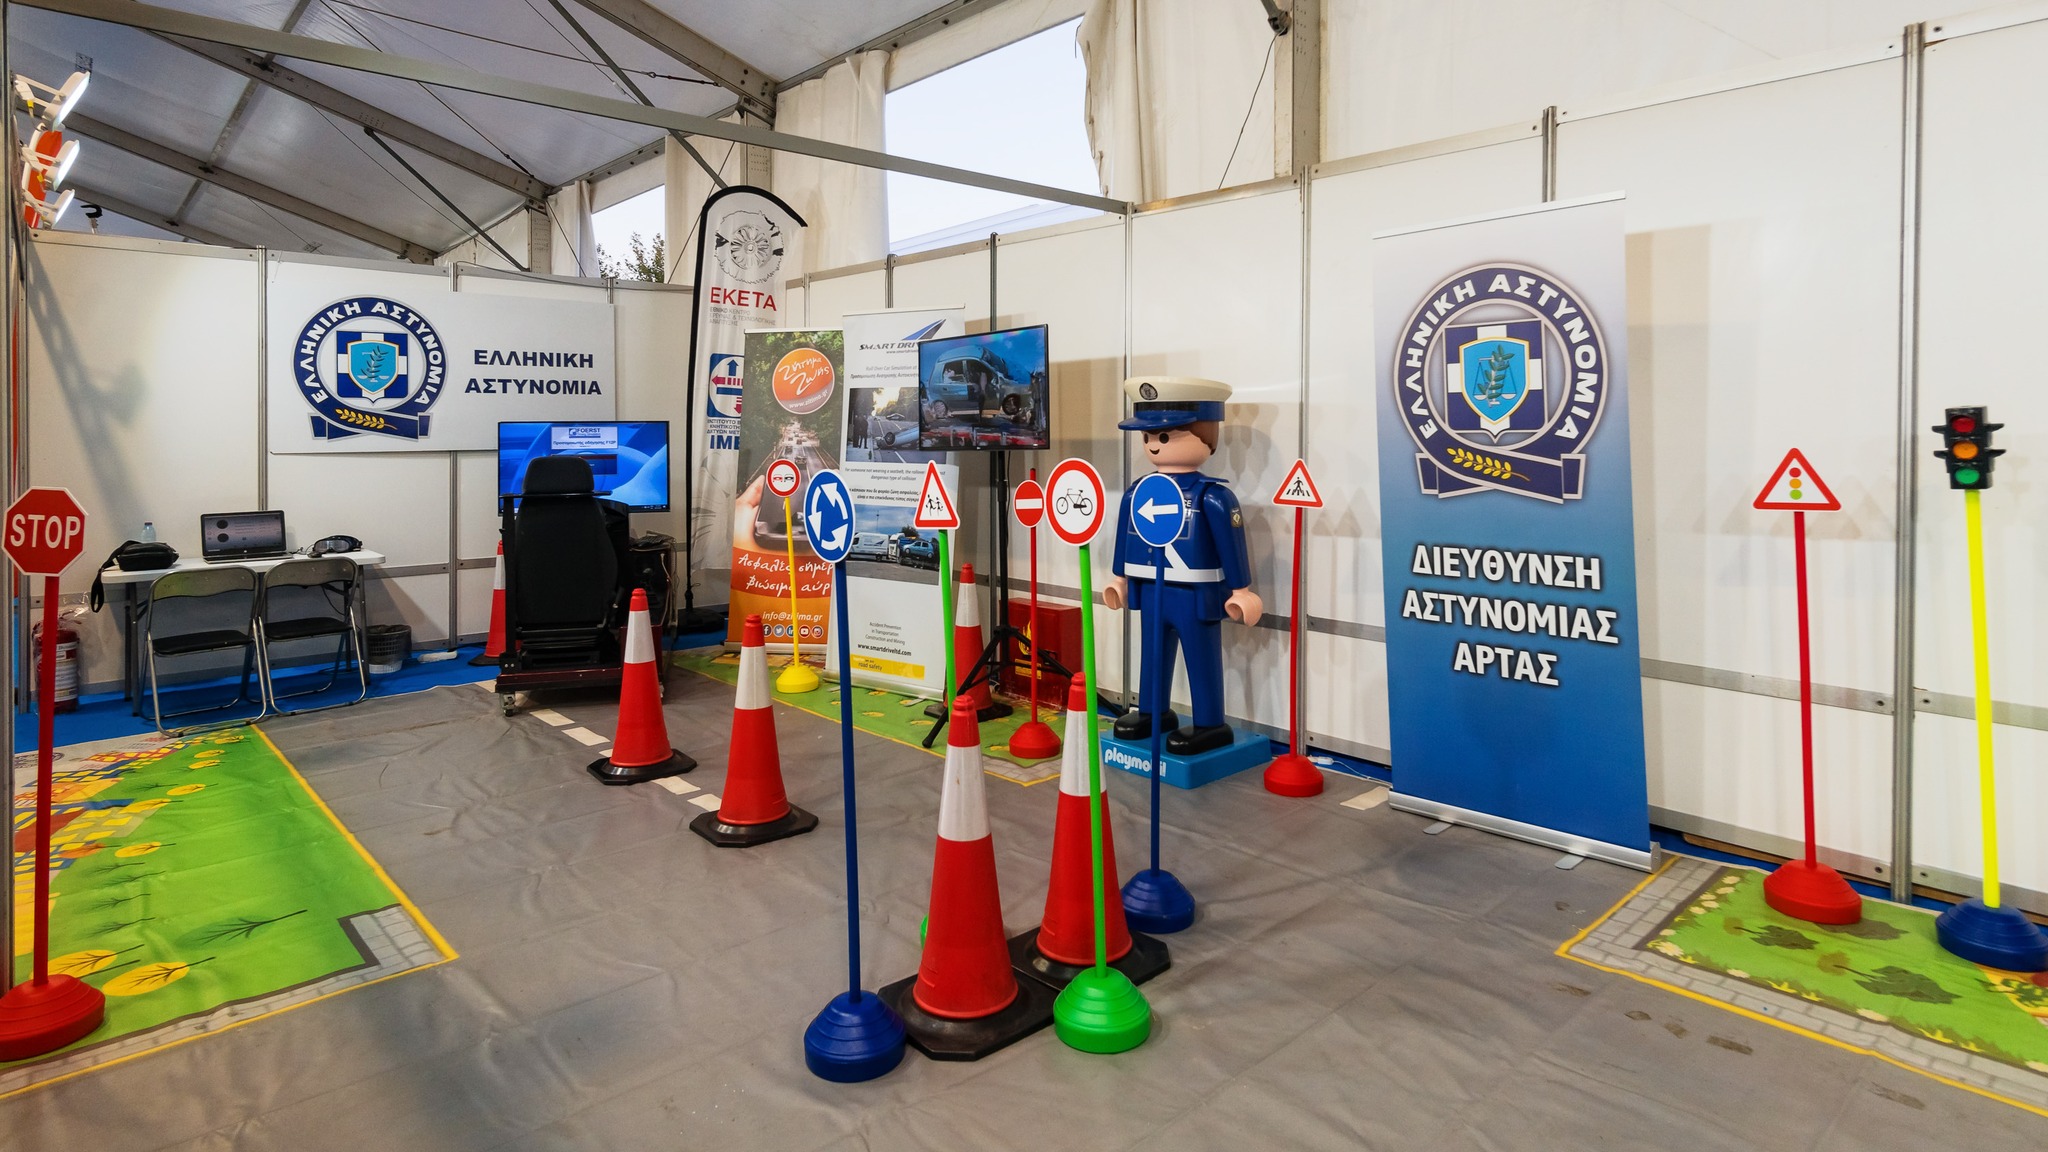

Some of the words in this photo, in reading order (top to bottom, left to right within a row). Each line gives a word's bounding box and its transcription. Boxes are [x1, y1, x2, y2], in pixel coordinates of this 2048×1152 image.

[300, 300, 362, 404] ΕΛΛΗΝΙΚΗ
[371, 301, 443, 406] ΑΣΤΥΝΟΜΙΑ
[474, 350, 594, 368] ΕΛΛΗΝΙΚΗ
[859, 342, 896, 350] SMART
[1405, 279, 1477, 440] ΕΛΛΗΝΙΚΗ
[1488, 273, 1598, 440] ΑΣΤΥΝΟΜΙΑ
[464, 378, 602, 396] ΑΣΤΥΝΟΜΙΑ
[10, 514, 81, 550] STOP
[1412, 544, 1601, 590] ΔΙΕΥΘΥΝΣΗ
[1402, 590, 1619, 644] ΑΣΤΥΝΟΜΙΑΣ
[1453, 642, 1560, 686] ΑΡΤΑΣ
[1104, 746, 1167, 778] playmoil
